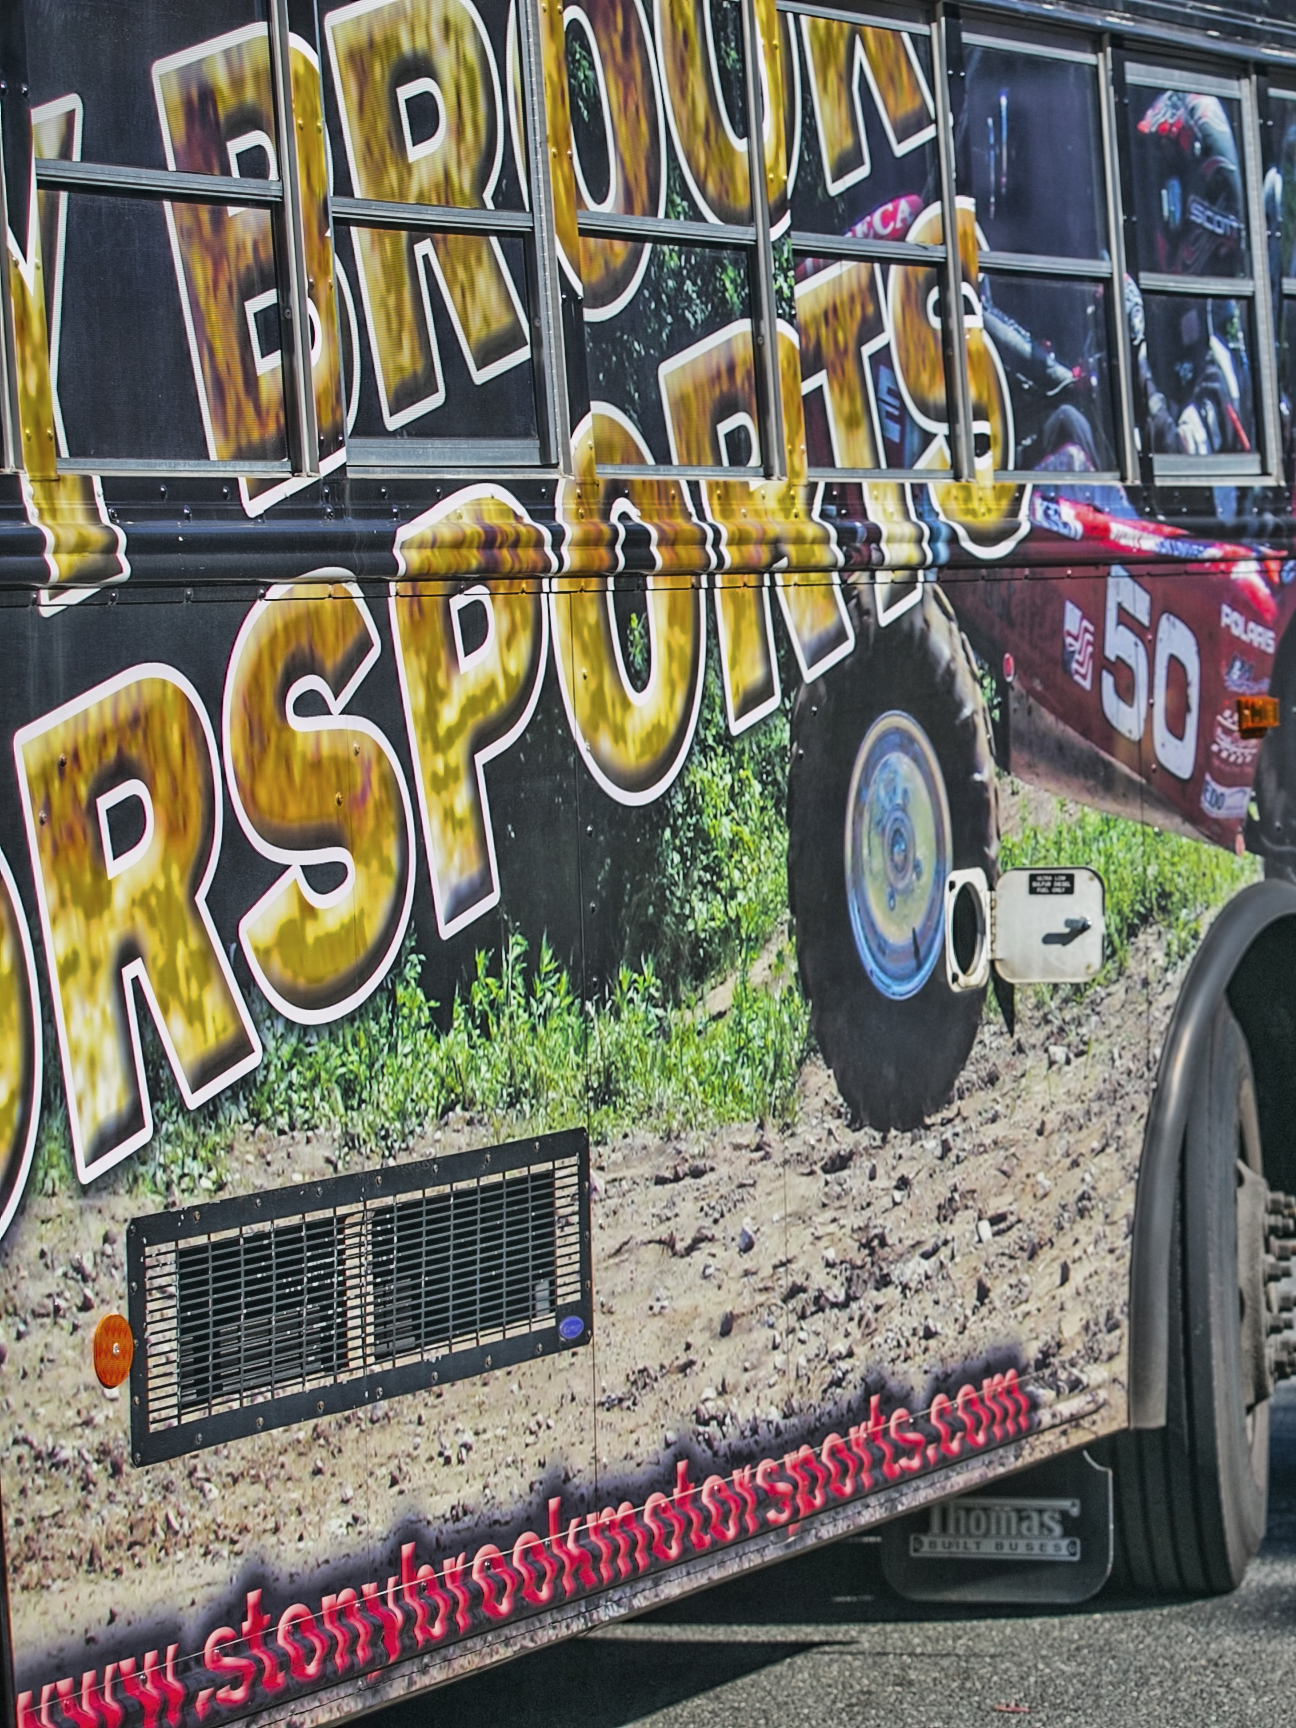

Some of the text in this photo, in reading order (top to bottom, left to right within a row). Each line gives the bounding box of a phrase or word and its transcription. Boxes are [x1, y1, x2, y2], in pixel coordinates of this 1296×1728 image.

[1220, 603, 1276, 655] POLARIS
[1101, 562, 1200, 780] 50
[0, 194, 1031, 1243] RSPORTS
[928, 1499, 1064, 1538] Thomas
[928, 1539, 1063, 1553] BUILT BUSES
